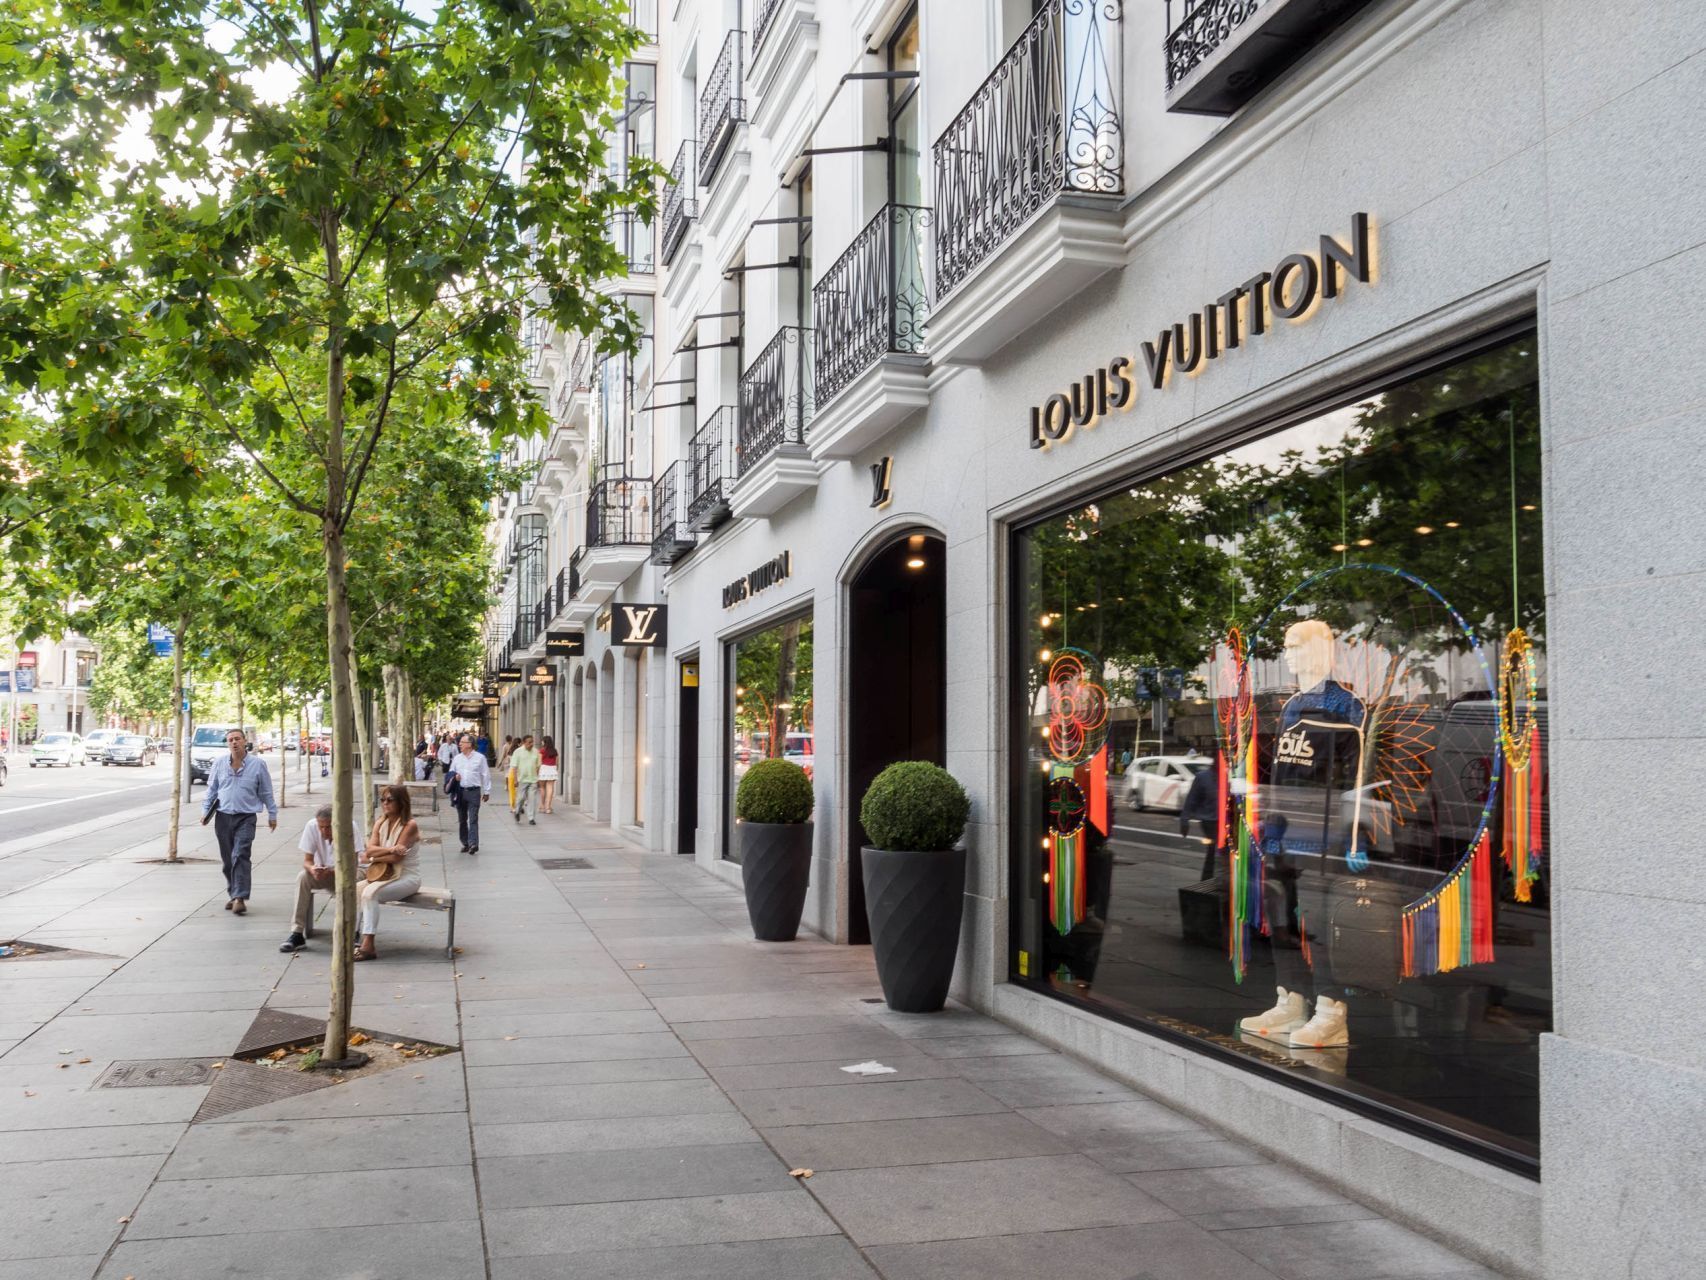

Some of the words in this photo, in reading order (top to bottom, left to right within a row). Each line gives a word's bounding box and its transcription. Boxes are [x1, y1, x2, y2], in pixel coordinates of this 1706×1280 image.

[1029, 356, 1131, 449] LOUIS
[1140, 212, 1369, 389] VUITTON
[622, 606, 658, 643] LV
